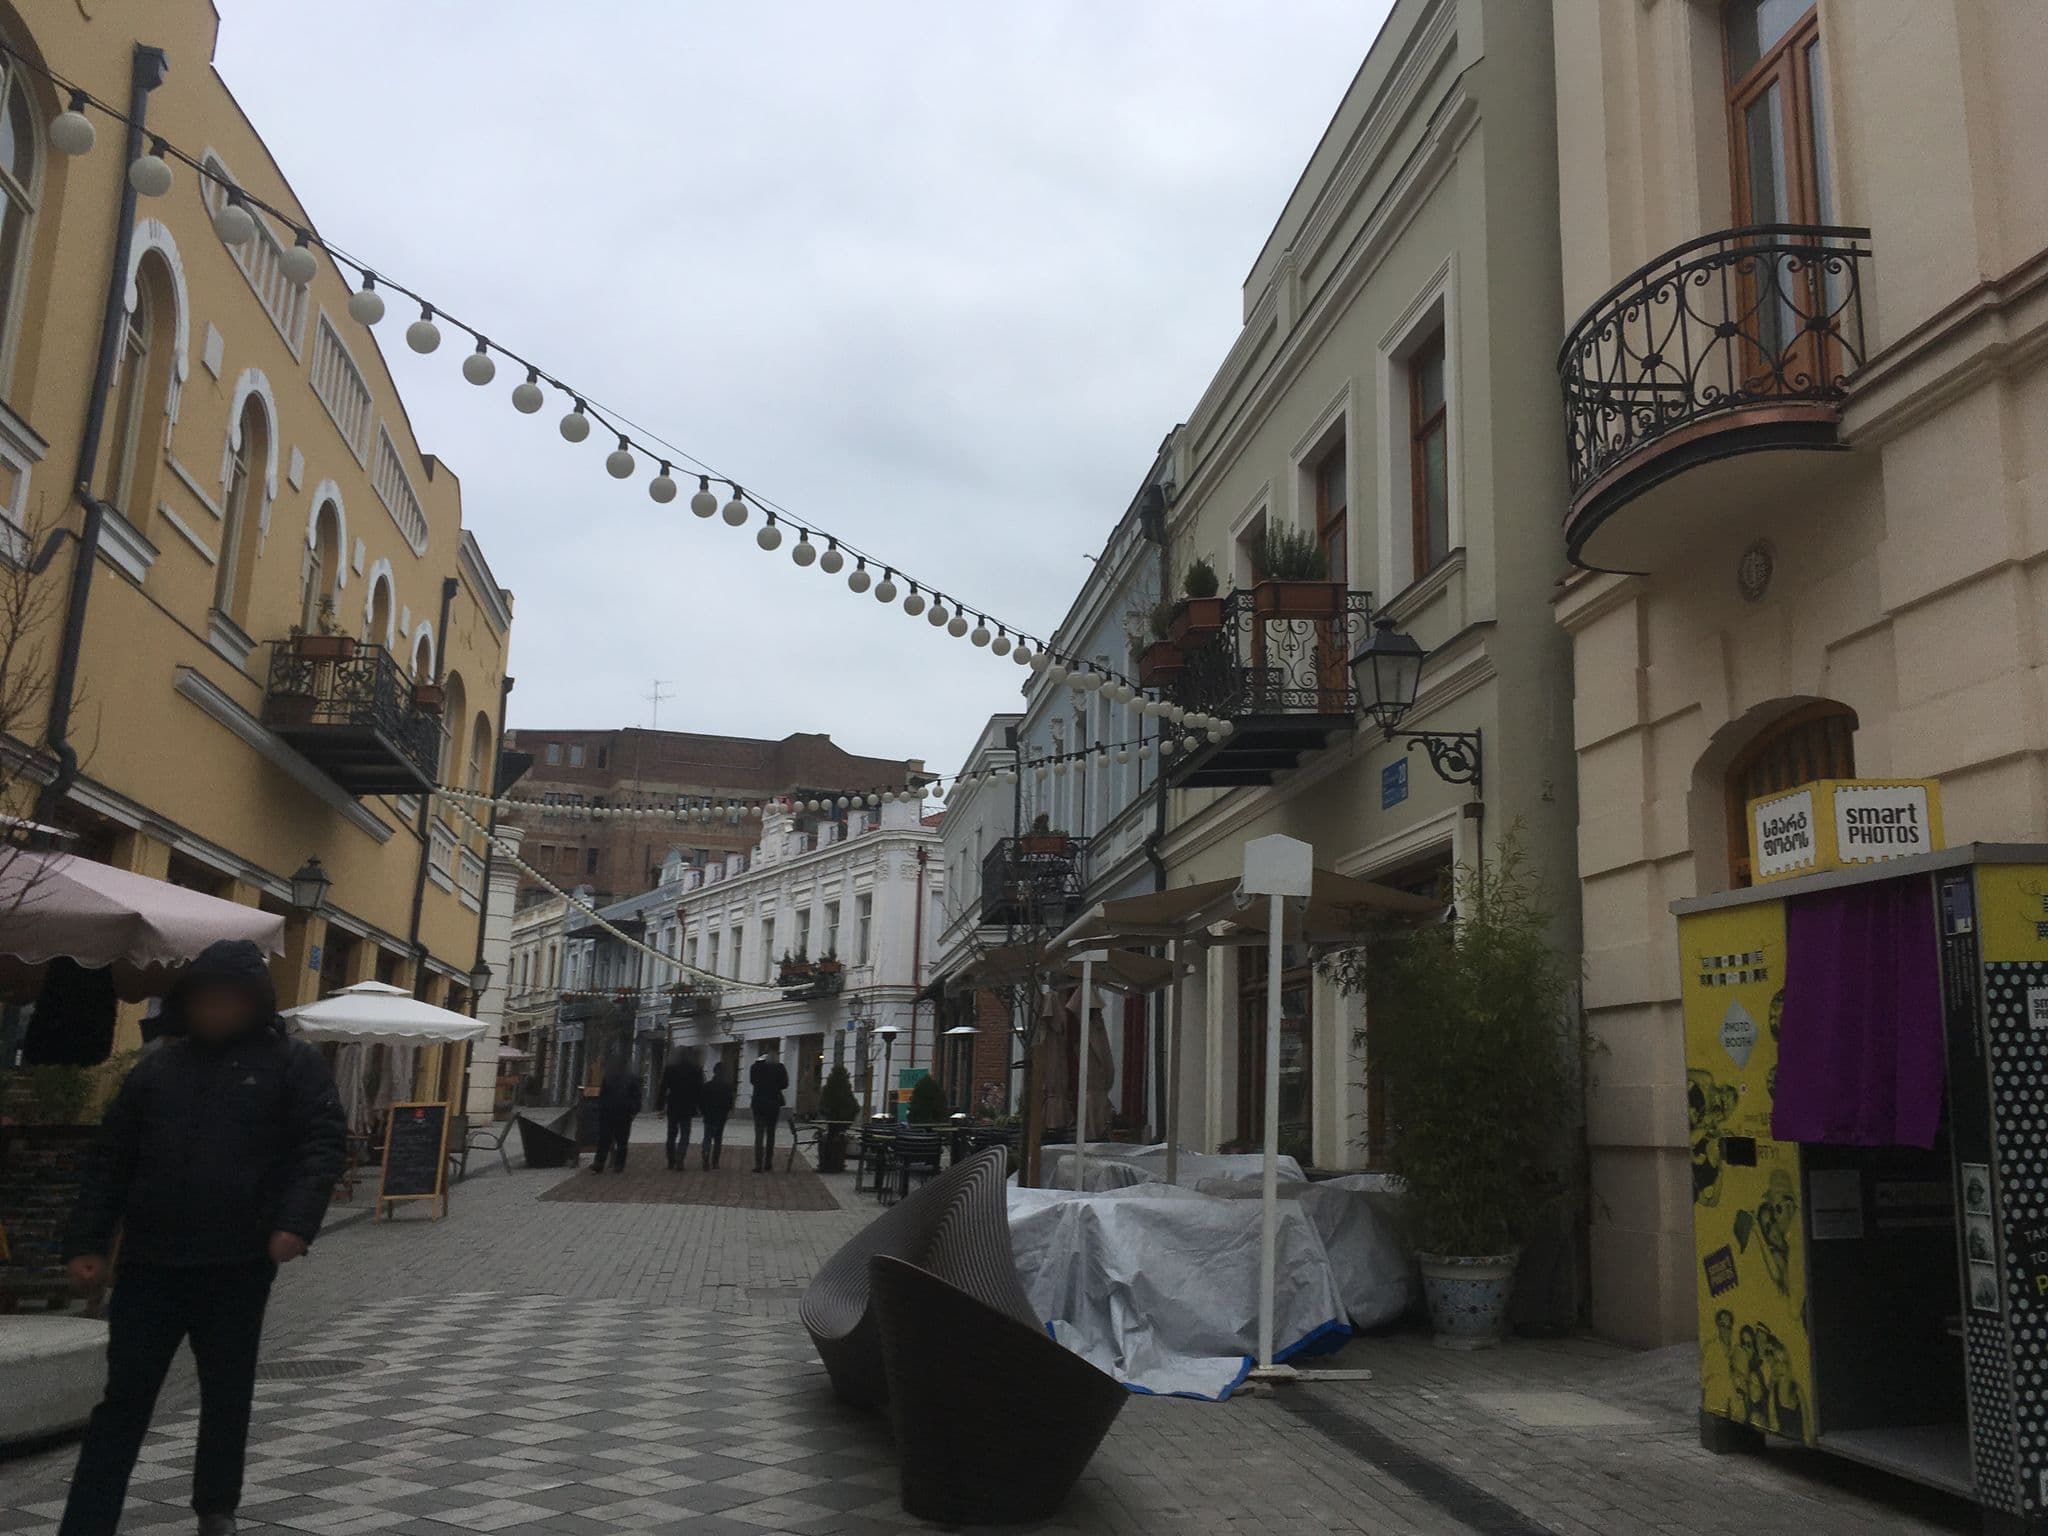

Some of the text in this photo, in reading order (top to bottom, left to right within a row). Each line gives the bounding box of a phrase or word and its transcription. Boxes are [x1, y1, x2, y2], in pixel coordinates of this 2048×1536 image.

[1763, 811, 1807, 838] სმარტ
[1846, 803, 1918, 825] smart
[1849, 825, 1920, 845] PHOTOS
